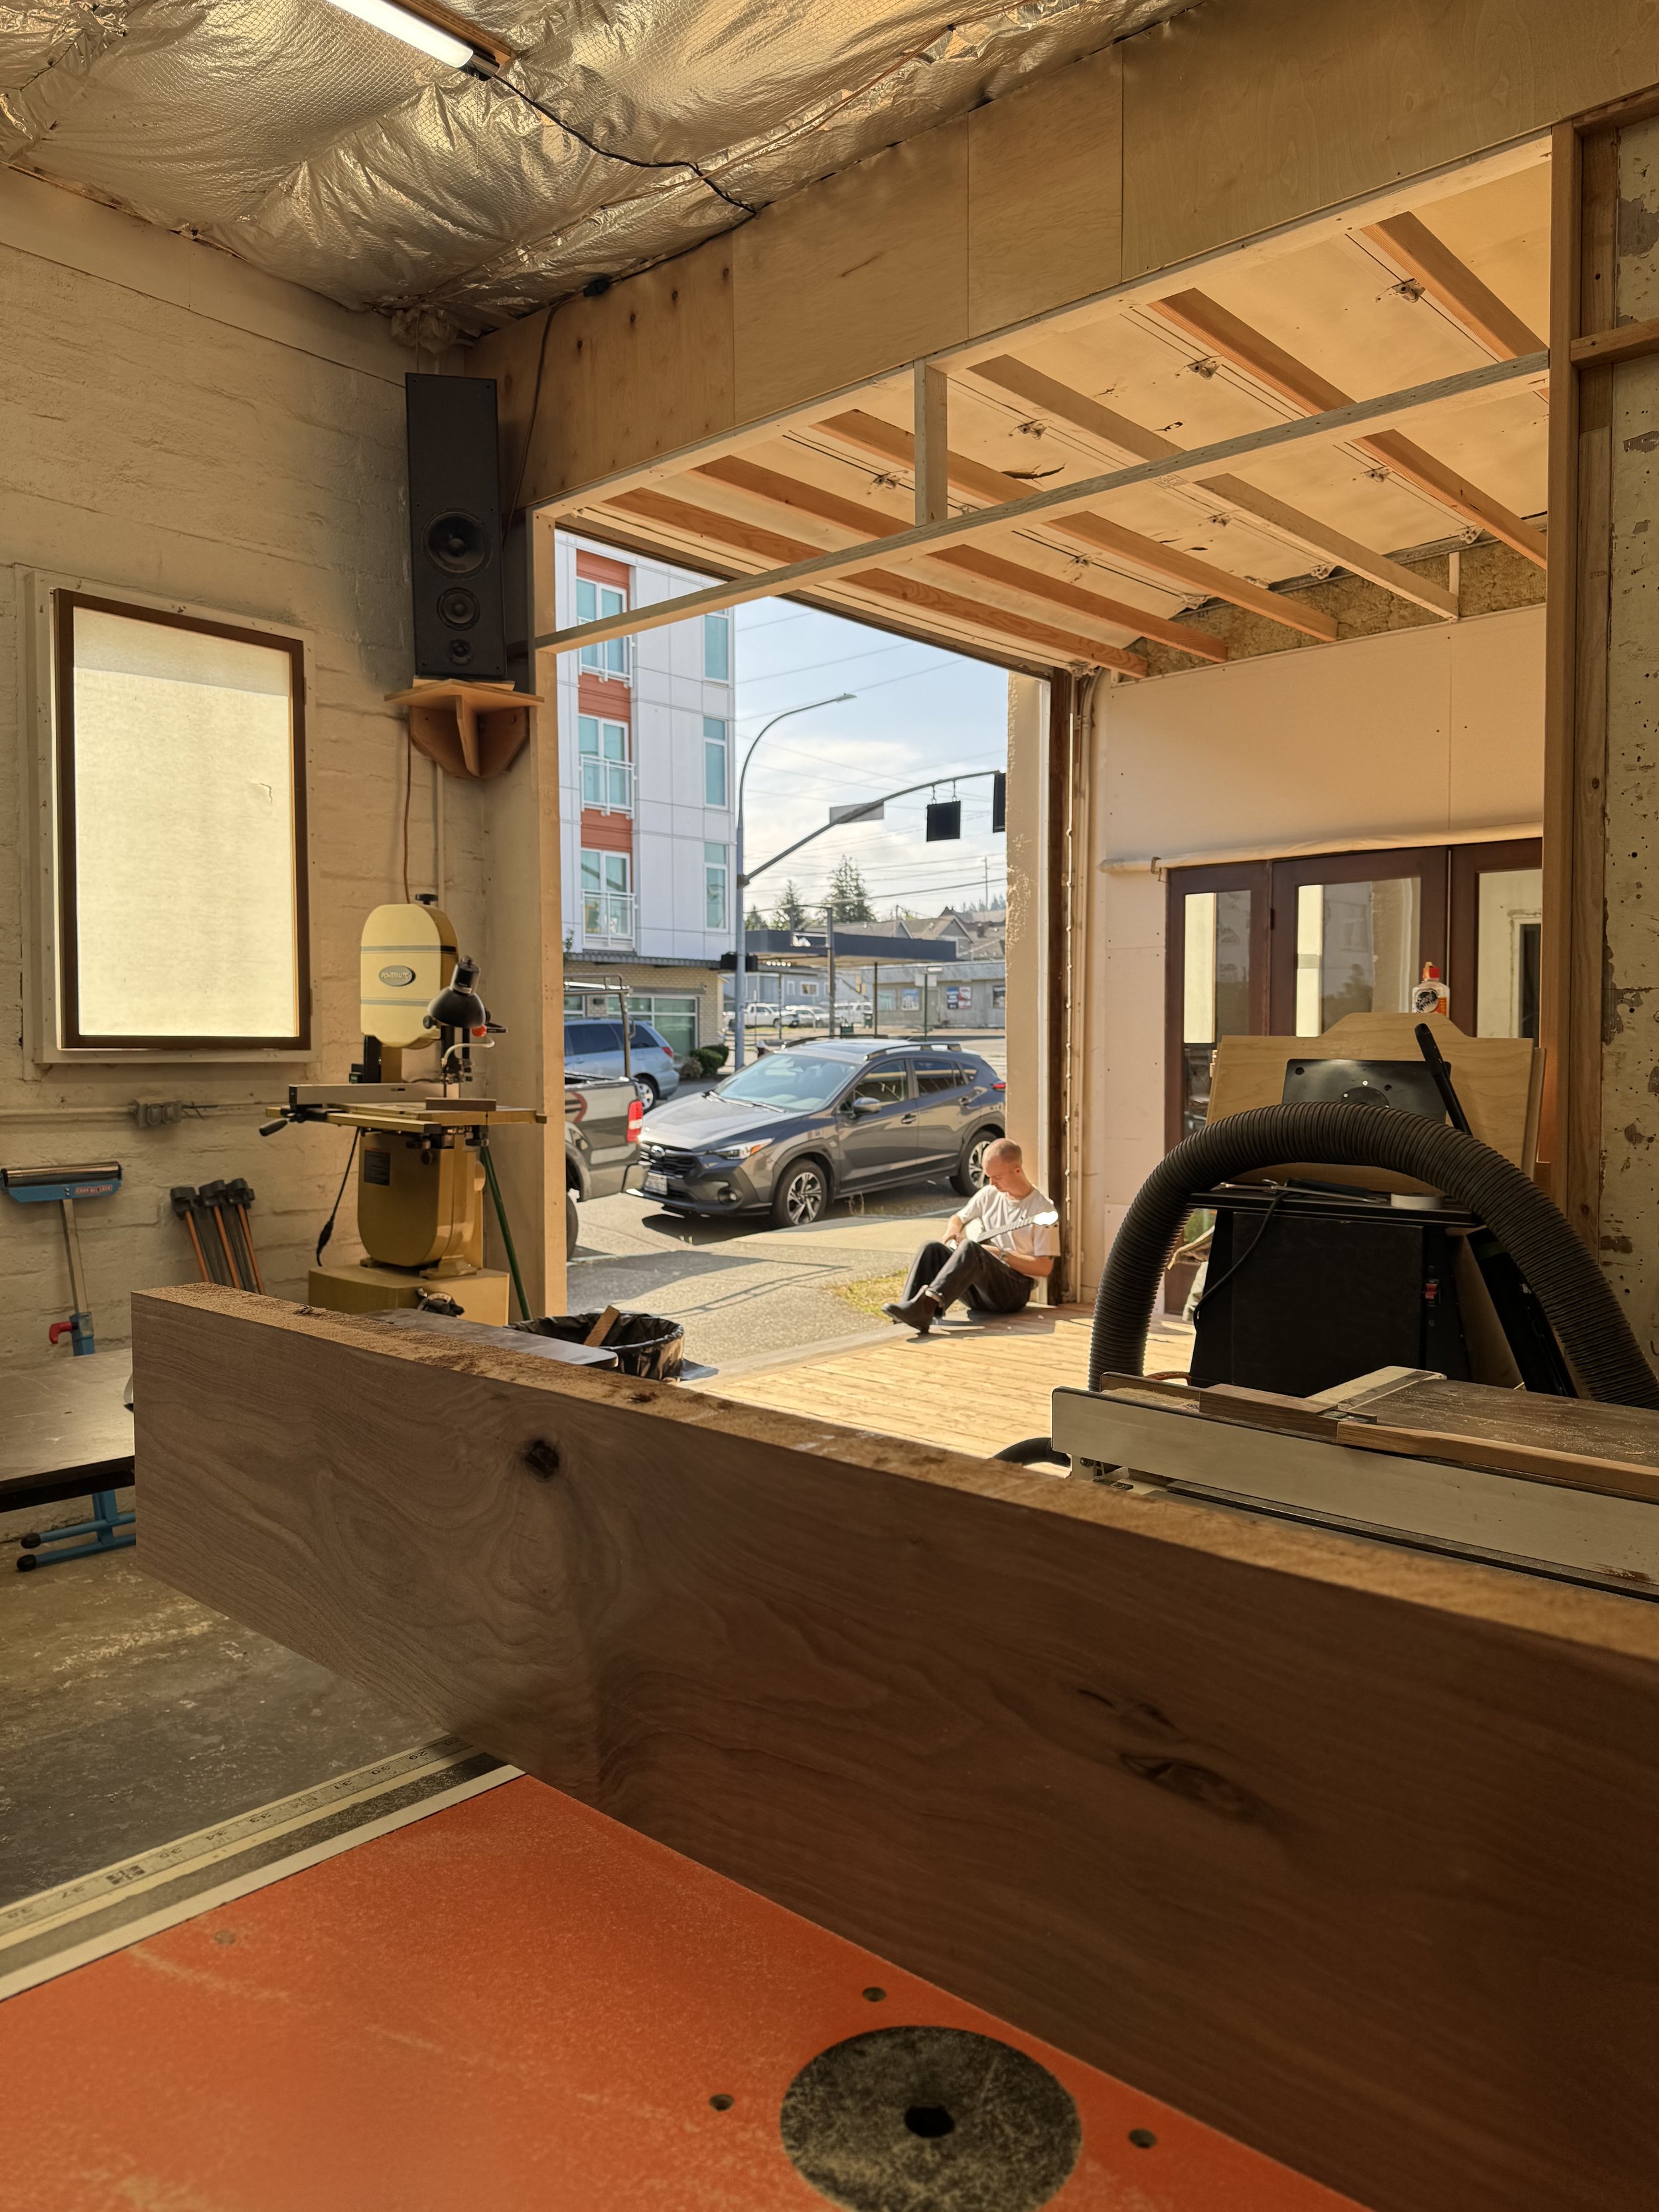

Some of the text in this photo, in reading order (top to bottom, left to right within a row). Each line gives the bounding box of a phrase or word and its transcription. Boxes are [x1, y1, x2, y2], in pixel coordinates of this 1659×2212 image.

[409, 1751, 427, 1760] 29
[371, 1764, 391, 1775] 30
[334, 1780, 352, 1789] 31
[249, 1812, 271, 1822] 33
